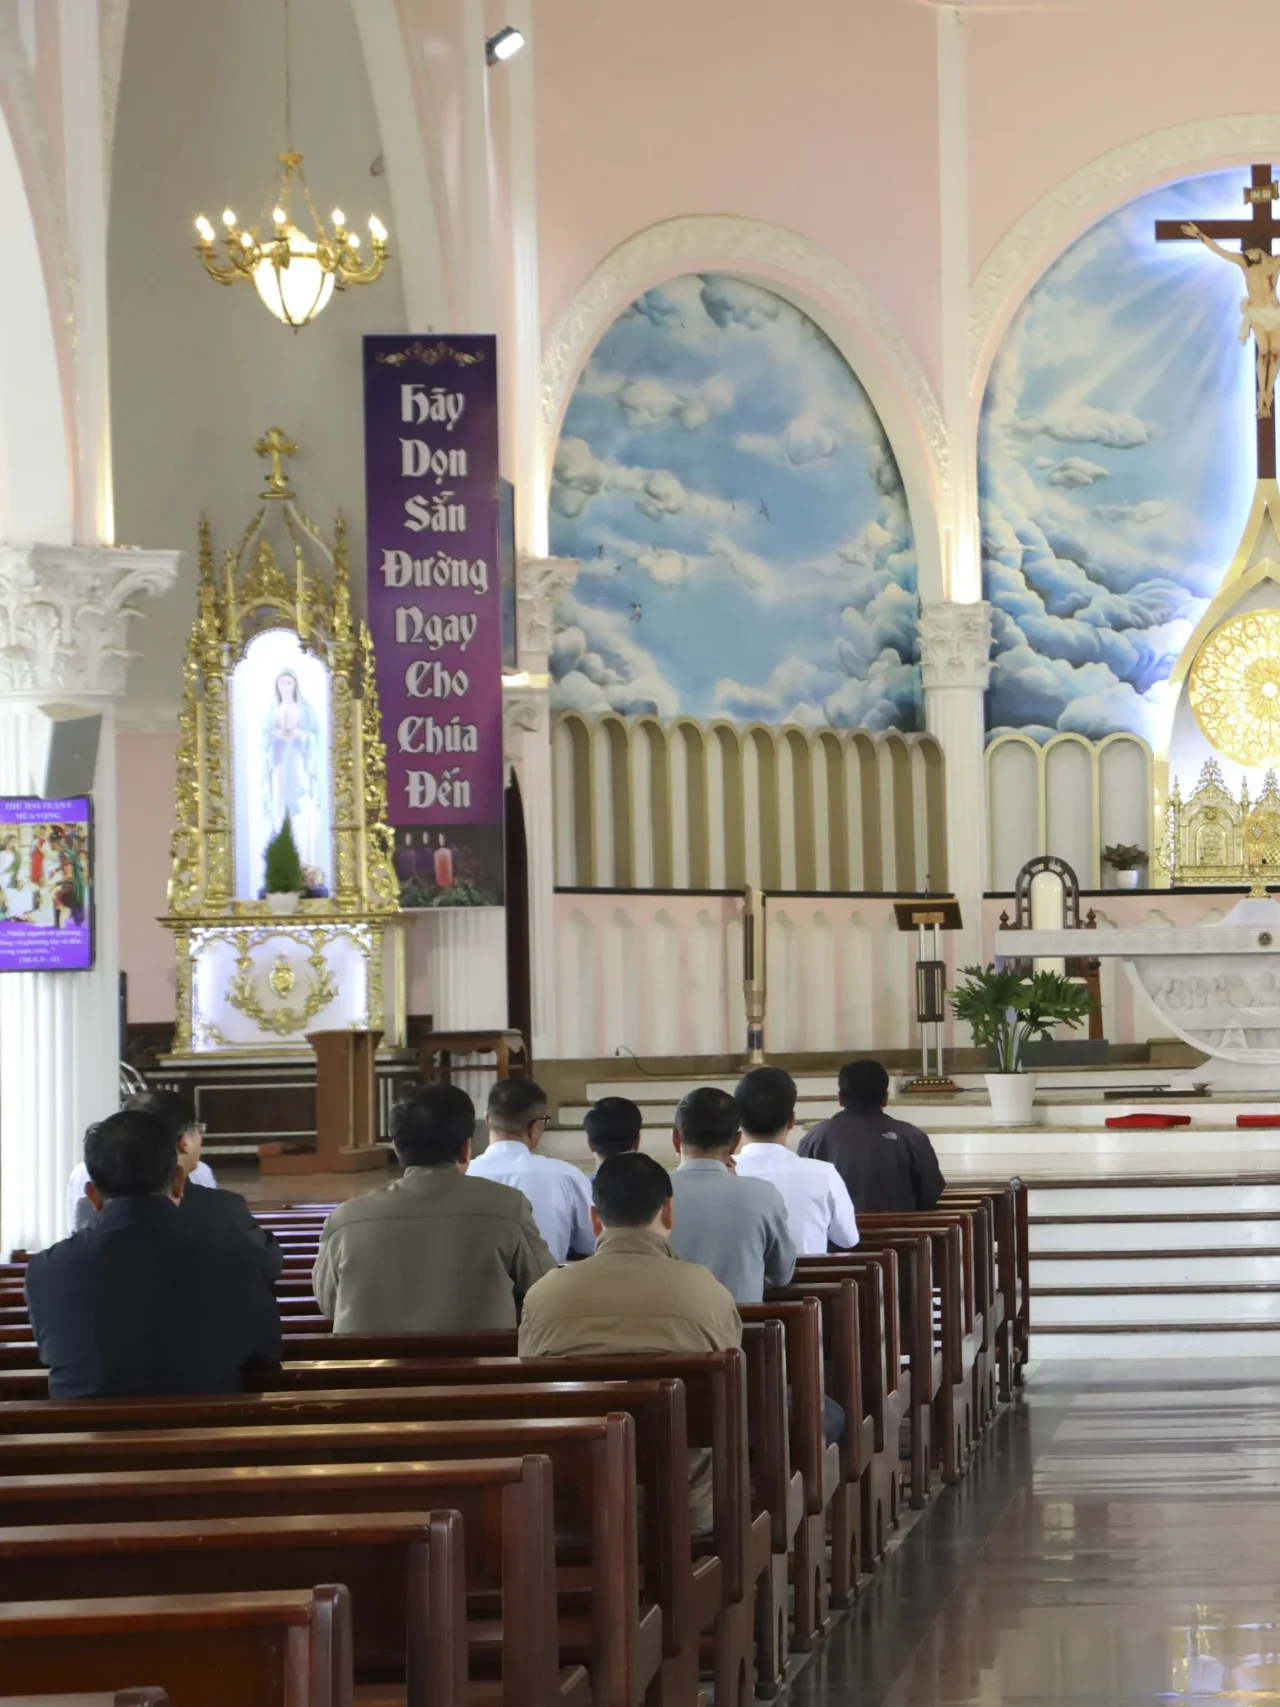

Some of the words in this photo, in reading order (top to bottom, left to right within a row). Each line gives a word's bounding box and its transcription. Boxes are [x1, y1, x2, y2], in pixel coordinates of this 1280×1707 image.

[400, 384, 464, 431] Hãy
[398, 437, 467, 485] Dọn
[403, 491, 466, 532] Sẵn
[380, 548, 489, 595] Đường
[394, 604, 477, 651] Ngay
[405, 660, 469, 699] Cho
[397, 715, 478, 755] Chúa
[404, 766, 471, 809] Đến
